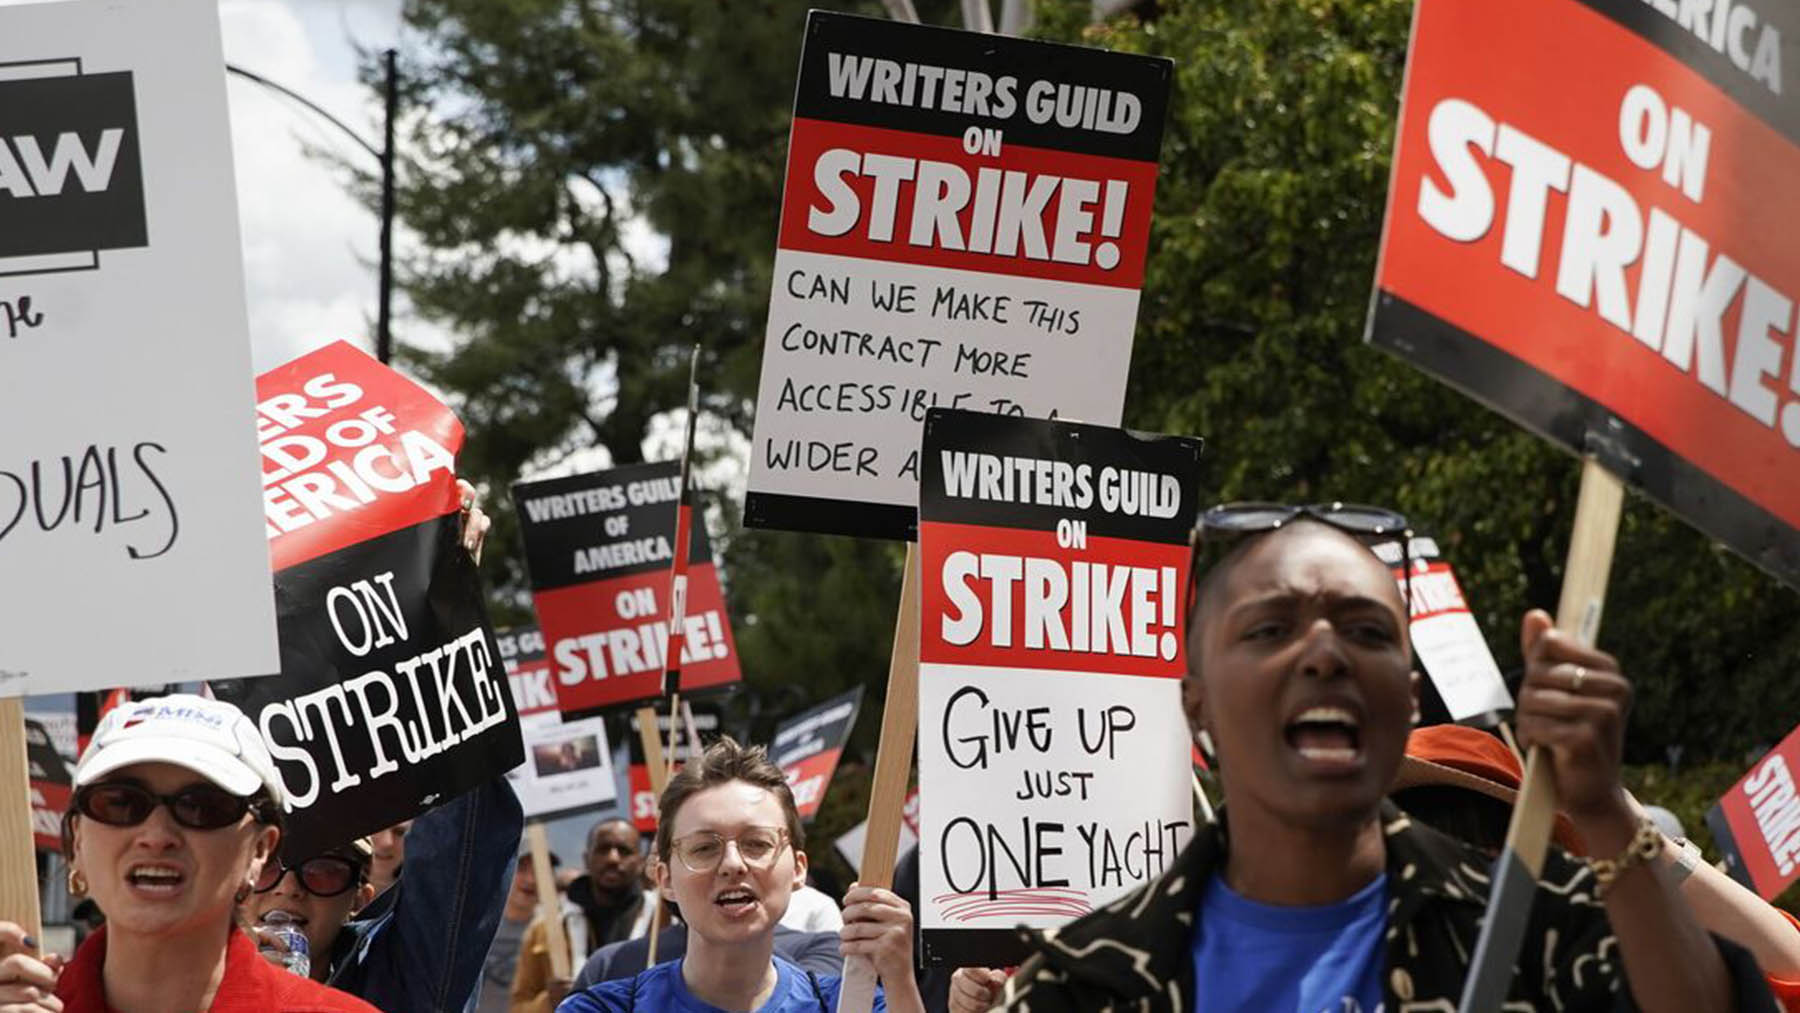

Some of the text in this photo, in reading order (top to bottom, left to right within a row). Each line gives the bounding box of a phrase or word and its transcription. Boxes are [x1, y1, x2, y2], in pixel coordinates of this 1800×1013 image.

[828, 52, 1142, 134] WRITERS GUILD
[963, 126, 1002, 157] ON
[1618, 84, 1711, 204] ON
[807, 148, 1129, 270] STRIKE!
[787, 270, 1081, 335] CAN WE MAKE THIS
[781, 323, 1032, 378] CONTRACT MORE
[326, 405, 397, 448] OF
[765, 438, 879, 477] WIDER
[264, 429, 456, 540] ERICA
[526, 485, 627, 523] WRITERS
[941, 450, 1181, 519] WRITERS GUILD
[574, 536, 673, 575] AMERICA
[604, 515, 630, 537] OF
[1057, 519, 1087, 549] ON
[326, 571, 409, 656] ON
[615, 588, 658, 620] ON
[941, 551, 1178, 661] STRIKE!
[258, 626, 507, 814] STRIKE
[942, 685, 1136, 770] GIVE UP
[1016, 770, 1094, 801] JUST
[941, 816, 1189, 901] ONE YACHT
